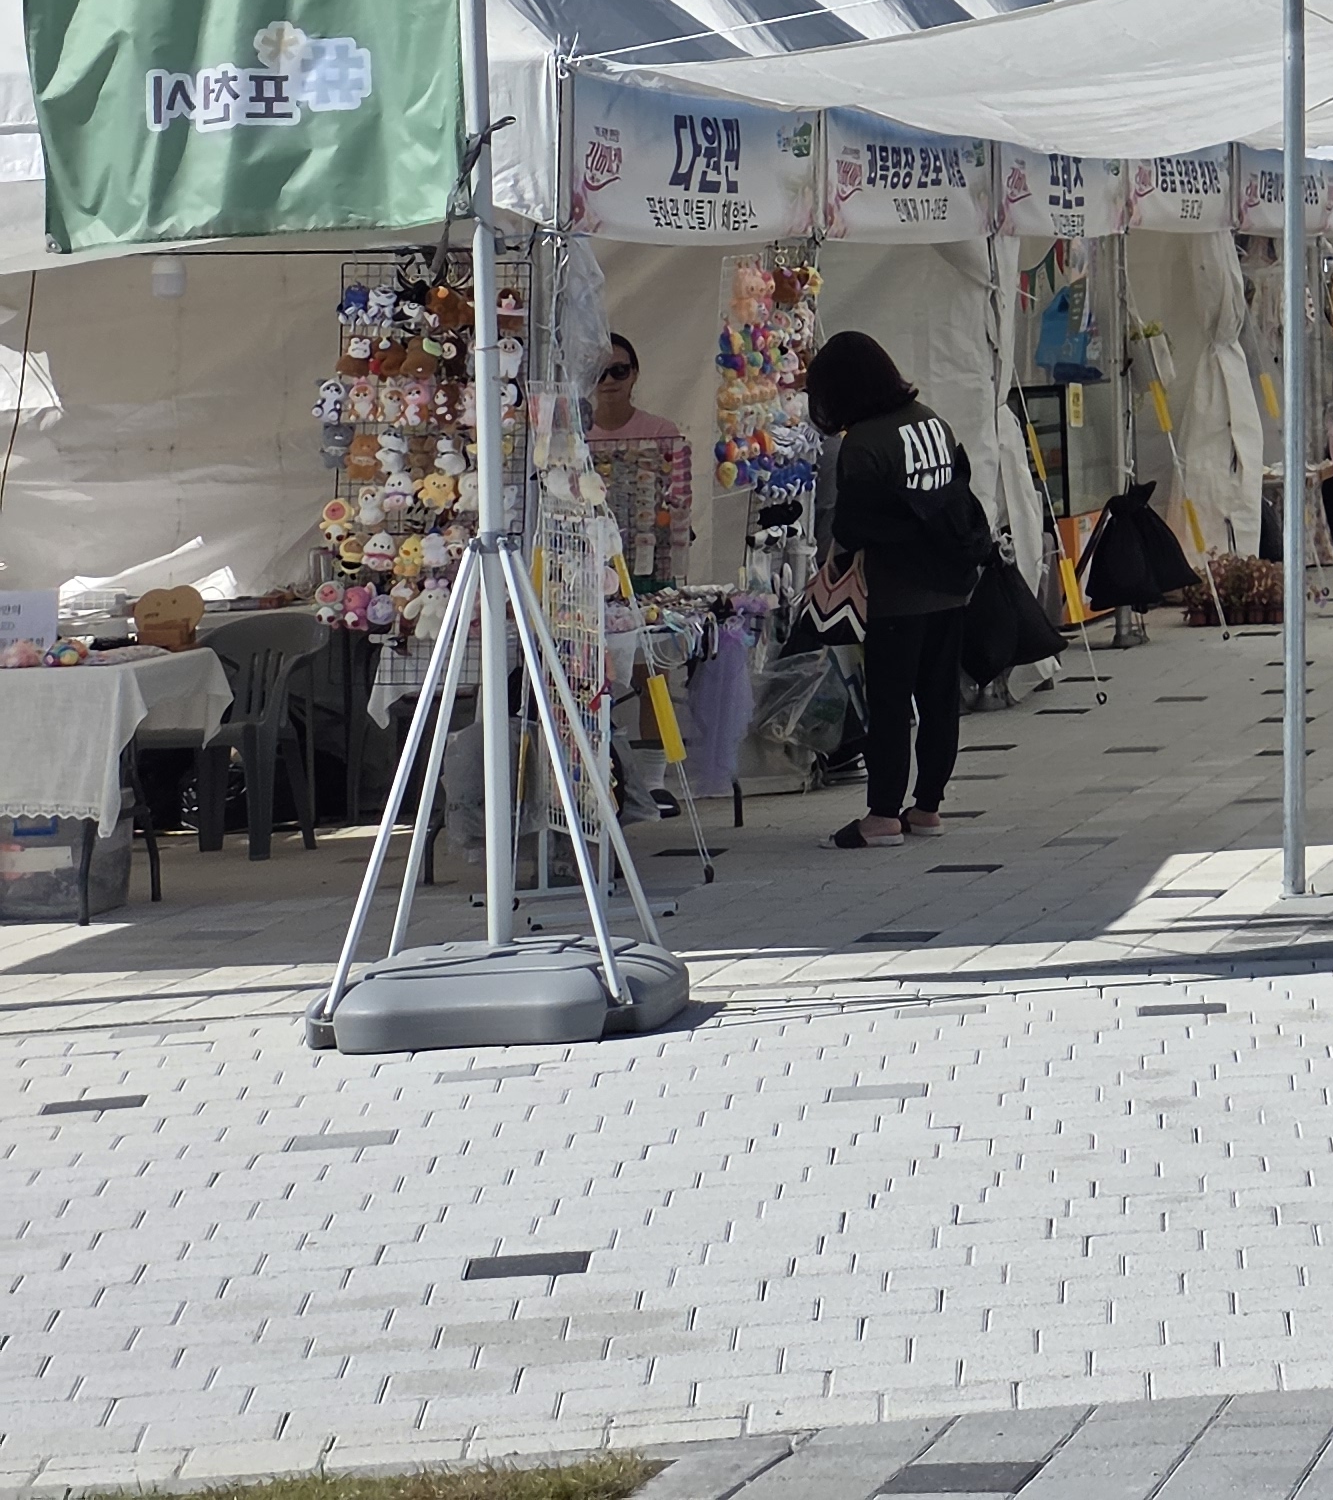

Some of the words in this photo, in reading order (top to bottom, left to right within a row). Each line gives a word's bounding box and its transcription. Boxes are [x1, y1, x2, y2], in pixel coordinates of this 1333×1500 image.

[683, 198, 717, 231] 만들기
[720, 198, 760, 232] 체험부스
[898, 417, 952, 475] AIR
